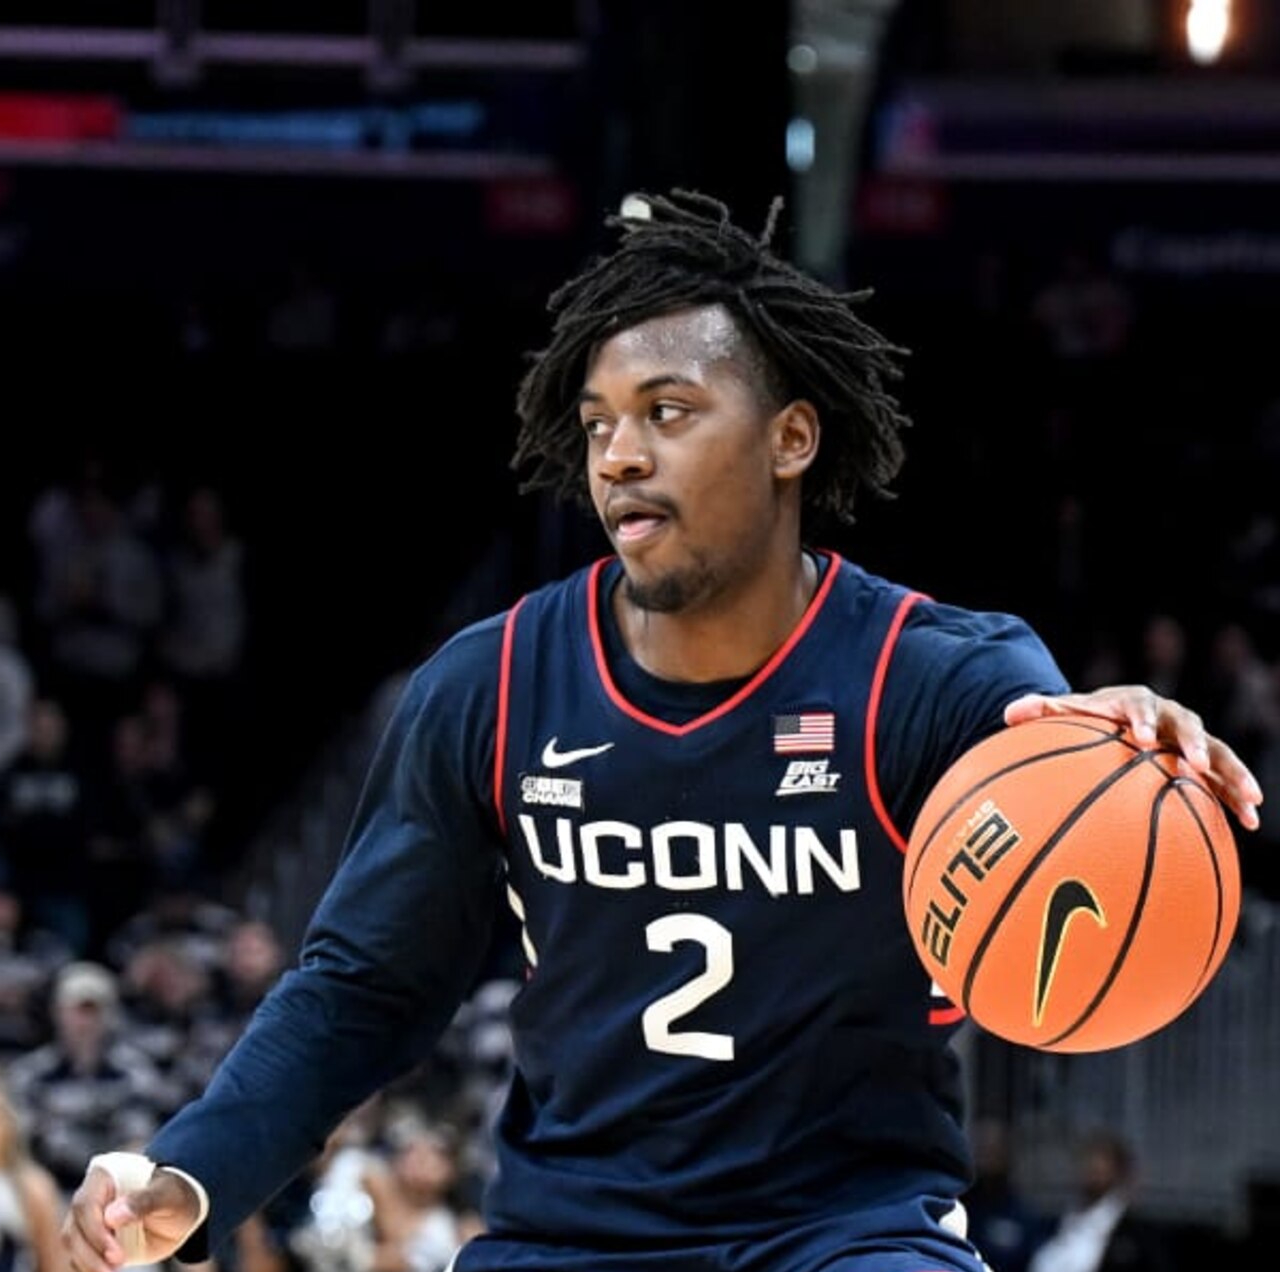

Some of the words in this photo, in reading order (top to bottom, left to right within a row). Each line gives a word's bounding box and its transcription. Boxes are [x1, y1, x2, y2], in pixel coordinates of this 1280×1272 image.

[780, 773, 841, 789] EAST
[519, 814, 861, 897] UCONN
[921, 812, 1021, 968] ELITE
[642, 913, 734, 1061] 2
